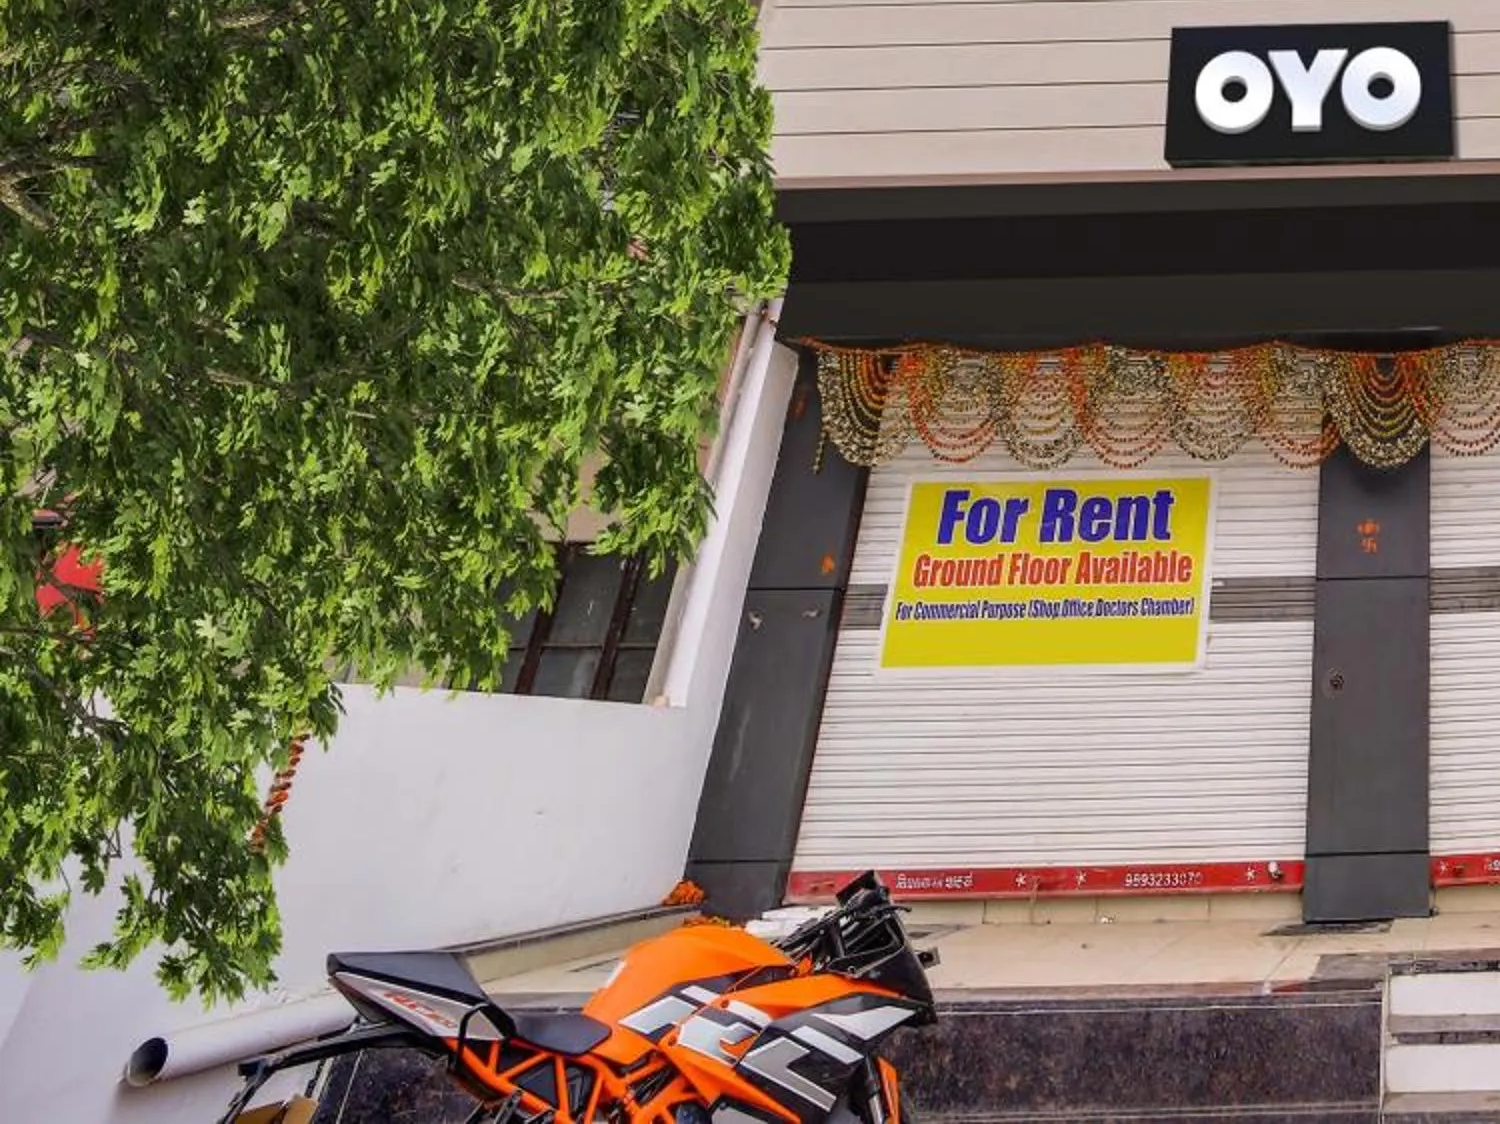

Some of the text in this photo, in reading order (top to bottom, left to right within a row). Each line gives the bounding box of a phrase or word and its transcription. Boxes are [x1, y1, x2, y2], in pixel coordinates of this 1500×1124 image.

[1195, 46, 1422, 134] OYO
[937, 488, 1175, 545] For Rent
[913, 549, 1192, 588] Ground Floor Available
[896, 601, 913, 620] For
[914, 600, 981, 620] Commercial
[982, 600, 1027, 620] Purpose
[1140, 596, 1195, 616] Chamber)
